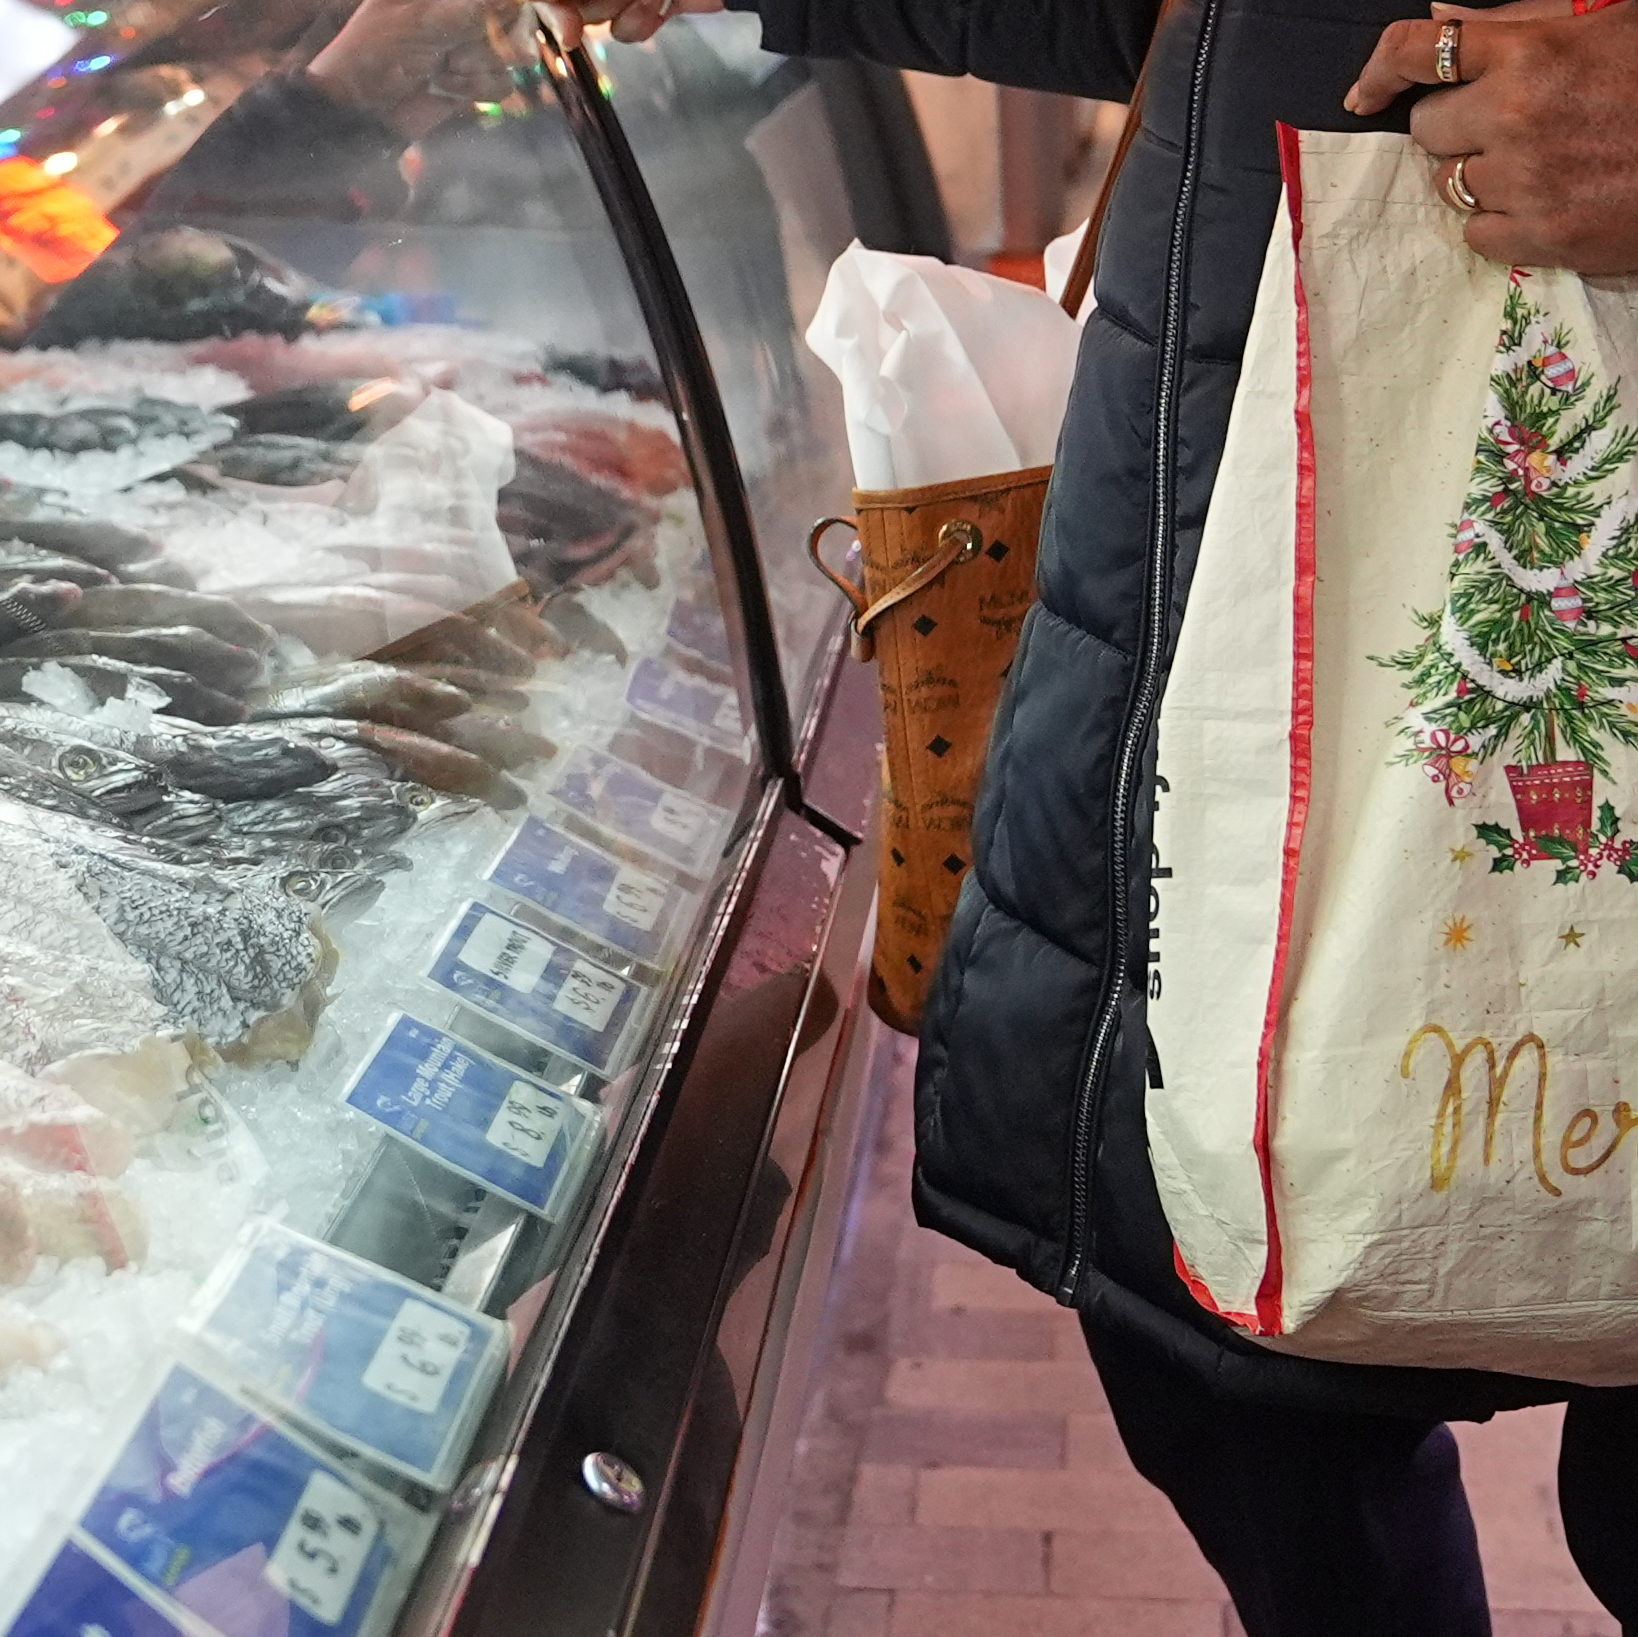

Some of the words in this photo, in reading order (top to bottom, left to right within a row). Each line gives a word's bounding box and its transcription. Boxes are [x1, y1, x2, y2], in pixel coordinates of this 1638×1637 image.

[490, 950, 520, 980] SILVER
[400, 1074, 430, 1108] Large
[416, 1036, 457, 1082] Mountain
[425, 1079, 457, 1112] Trout
[445, 1050, 476, 1089] (Hake)
